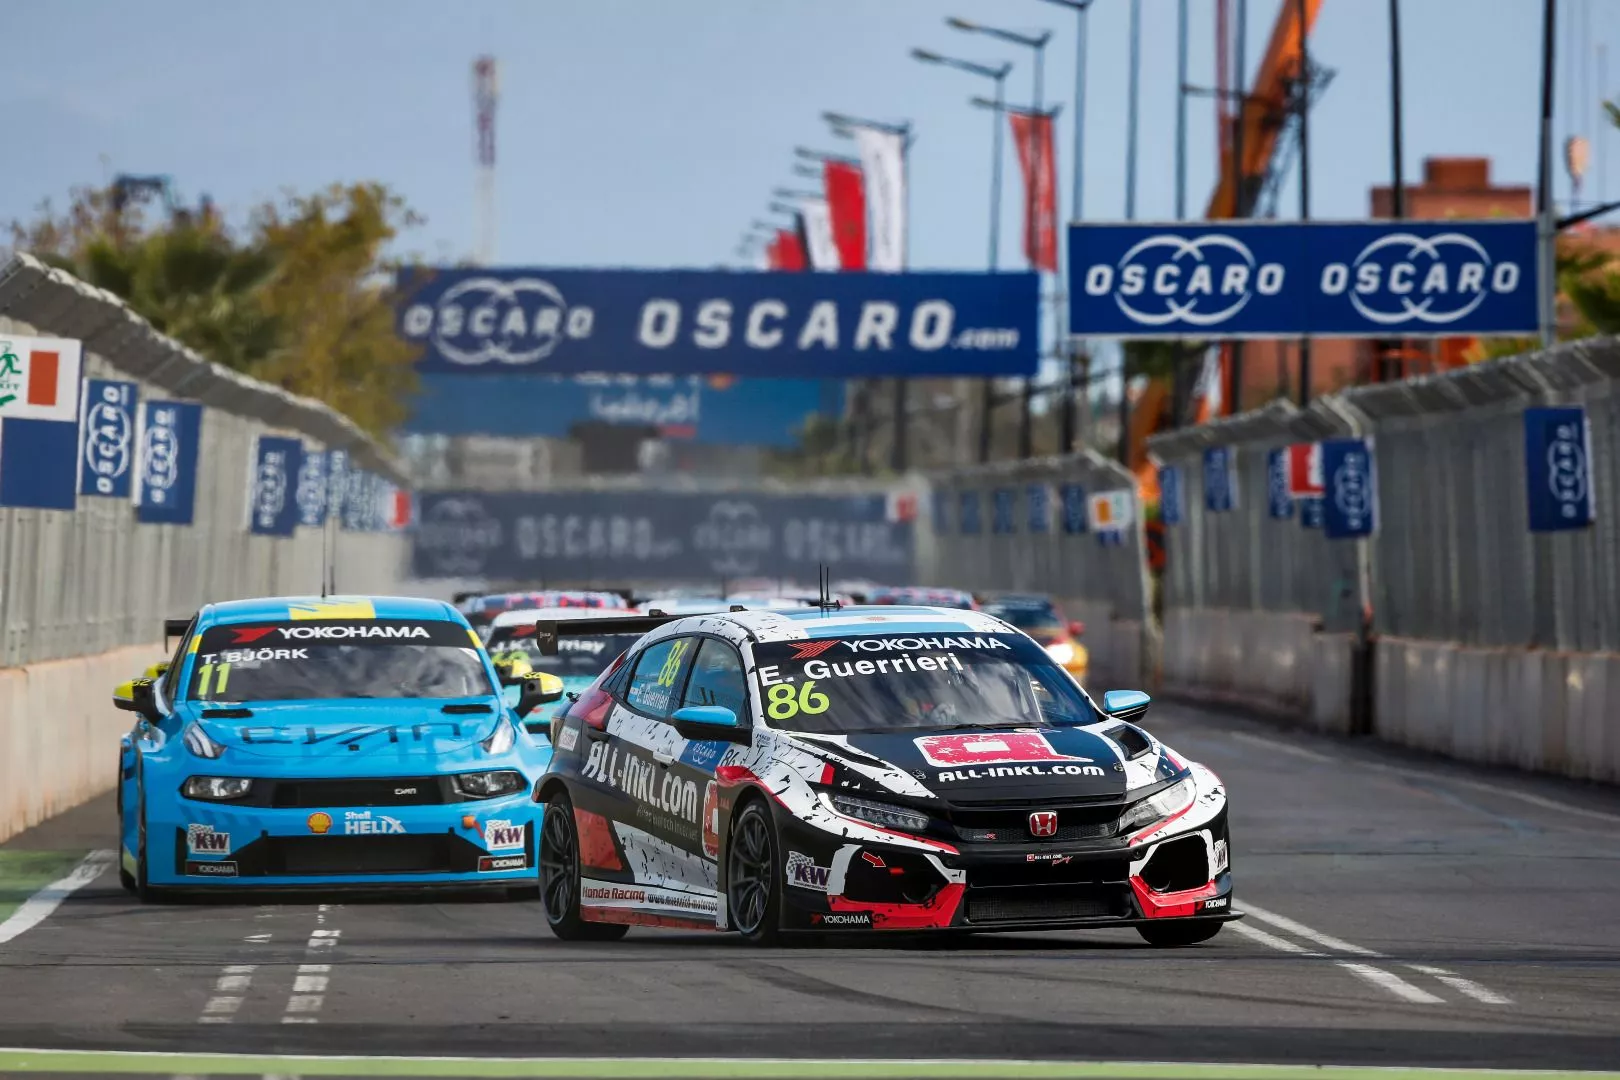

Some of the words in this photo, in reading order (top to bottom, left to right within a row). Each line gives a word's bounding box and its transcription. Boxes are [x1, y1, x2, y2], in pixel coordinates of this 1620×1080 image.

[1085, 262, 1286, 296] OSCARO
[1320, 261, 1521, 295] OSCARO
[403, 303, 596, 339] OSCARO
[638, 298, 1020, 351] OSCARO.com
[96, 385, 121, 494] OSCARO
[277, 625, 431, 640] YOKOHAMA
[841, 636, 1012, 653] YOKOHAMA
[201, 653, 219, 665] T.
[226, 647, 310, 663] BJÖRK
[657, 640, 689, 688] 86
[197, 662, 232, 696] 11
[758, 664, 795, 687] E.
[802, 652, 964, 681] Guerrieri
[766, 680, 830, 720] 86
[344, 810, 372, 821] Shell
[344, 815, 407, 834] HELIX
[195, 832, 228, 850] KW
[493, 827, 523, 845] KW
[198, 864, 236, 874] YOKOHAMA
[491, 858, 525, 868] YOKOHAMA
[794, 862, 832, 886] KW
[582, 886, 612, 899] Honda
[611, 887, 645, 904] Racing
[823, 914, 871, 924] YOKOHAMA
